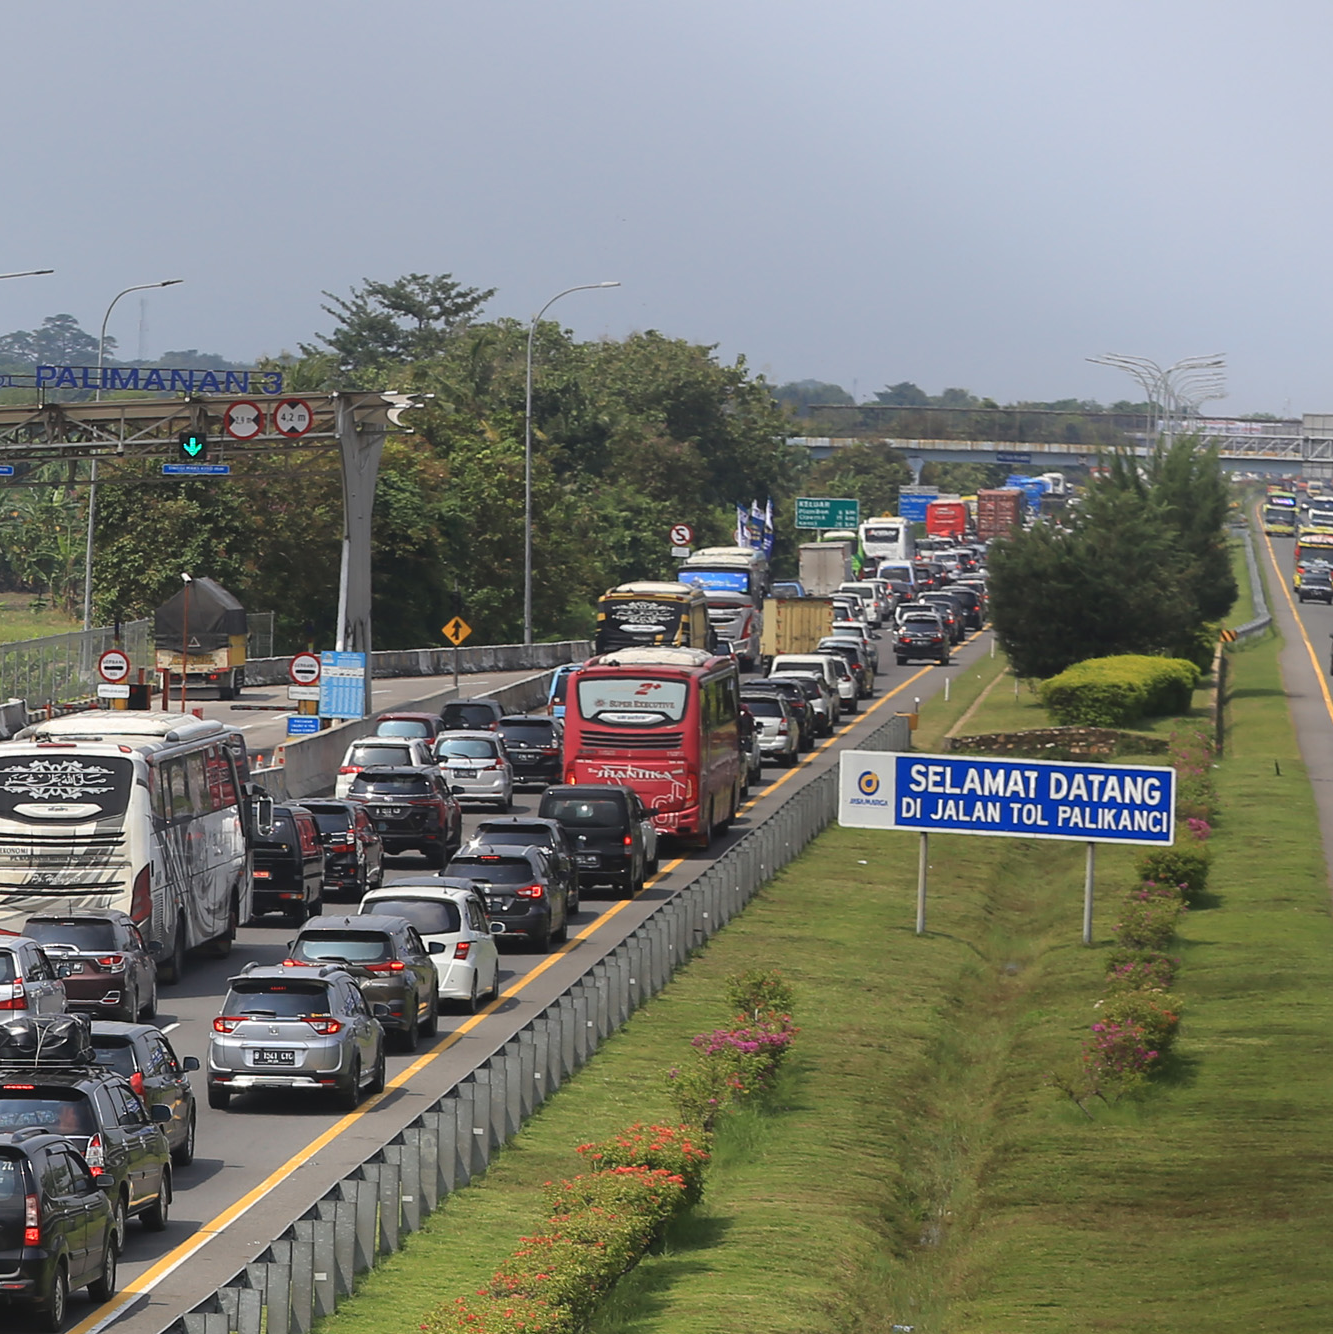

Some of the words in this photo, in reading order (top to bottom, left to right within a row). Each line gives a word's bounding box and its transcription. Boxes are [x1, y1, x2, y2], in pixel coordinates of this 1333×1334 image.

[36, 365, 250, 395] PALIMANAN
[261, 371, 283, 395] 3
[281, 412, 294, 422] 4,2
[297, 414, 307, 422] m
[609, 700, 633, 708] SUPER
[909, 763, 1039, 799] SELAMAT
[1049, 770, 1162, 807] DATANG
[901, 796, 922, 819] DI
[929, 798, 1001, 823] JALAN
[1009, 802, 1049, 827] TOL
[1057, 805, 1168, 834] PALIKANCI
[0, 847, 29, 855] EKONOMI
